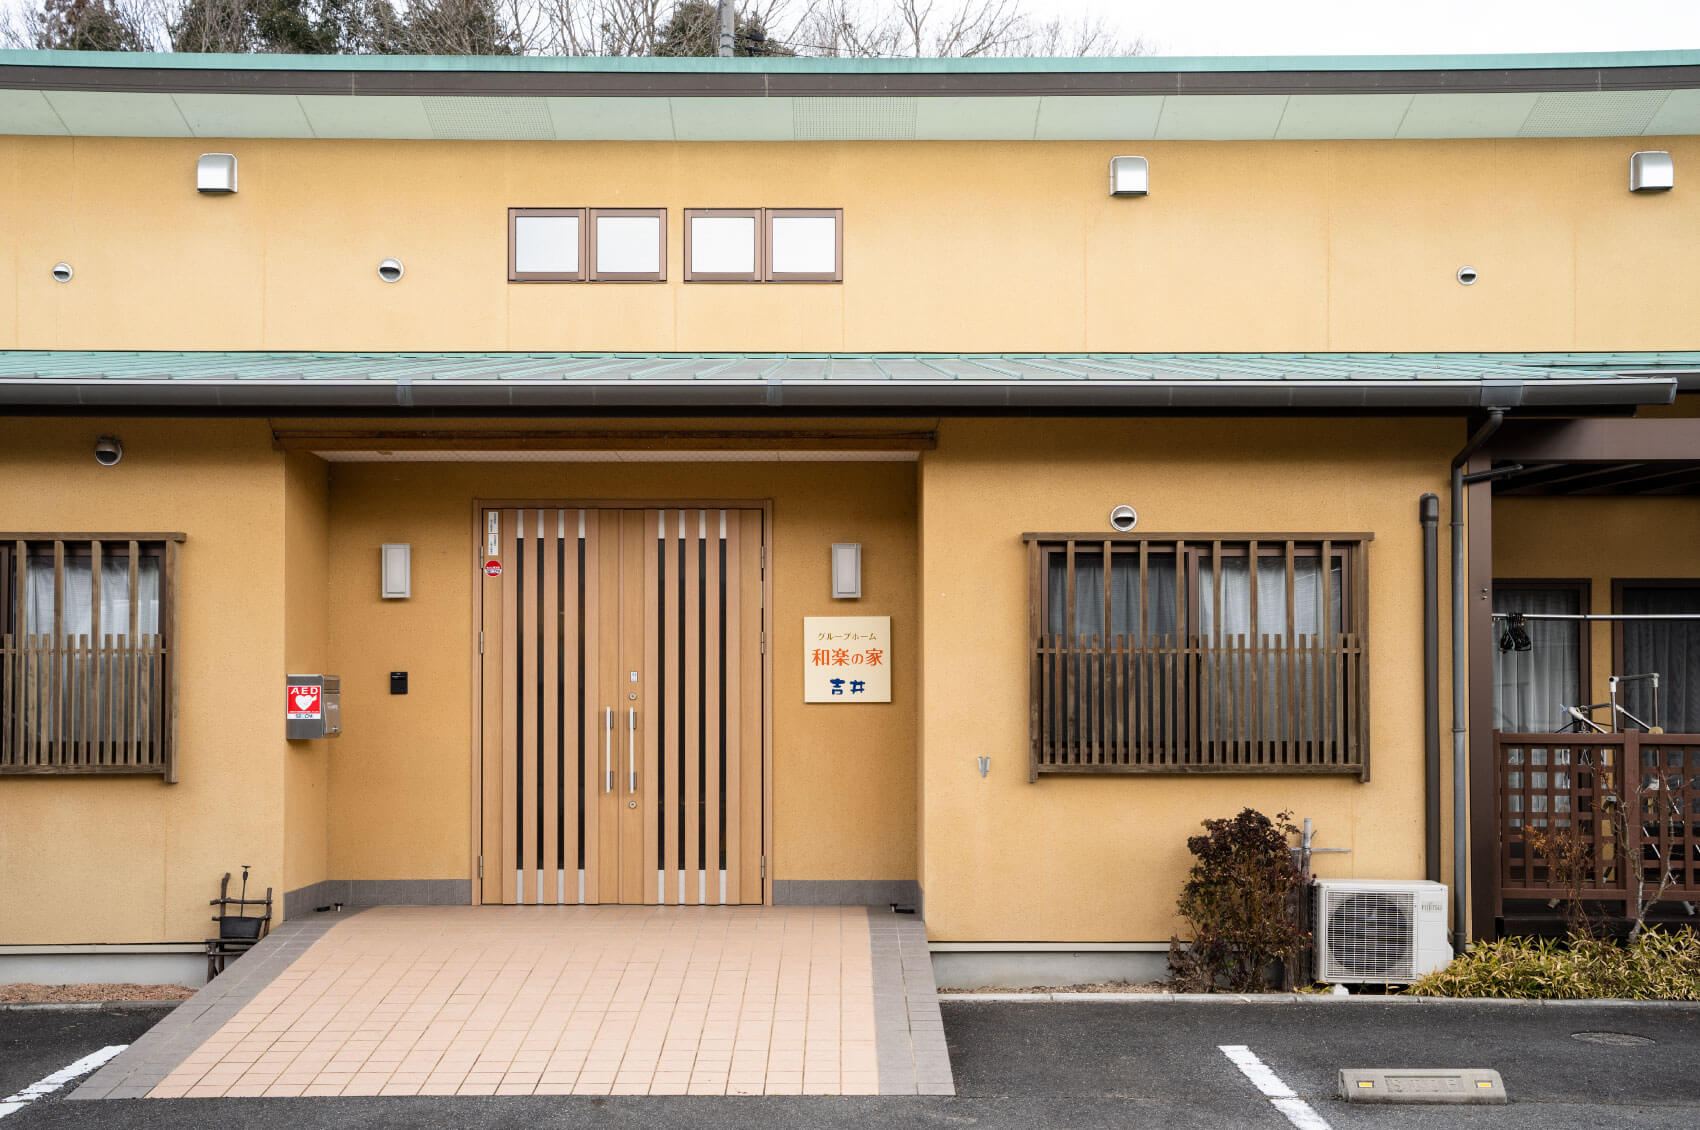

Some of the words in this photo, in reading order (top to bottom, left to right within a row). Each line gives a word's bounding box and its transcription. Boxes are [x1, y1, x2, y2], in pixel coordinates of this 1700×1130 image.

[818, 632, 877, 641] グループホーム
[811, 648, 884, 667] 和楽の家
[290, 687, 319, 695] AED
[830, 678, 866, 695] 吉井
